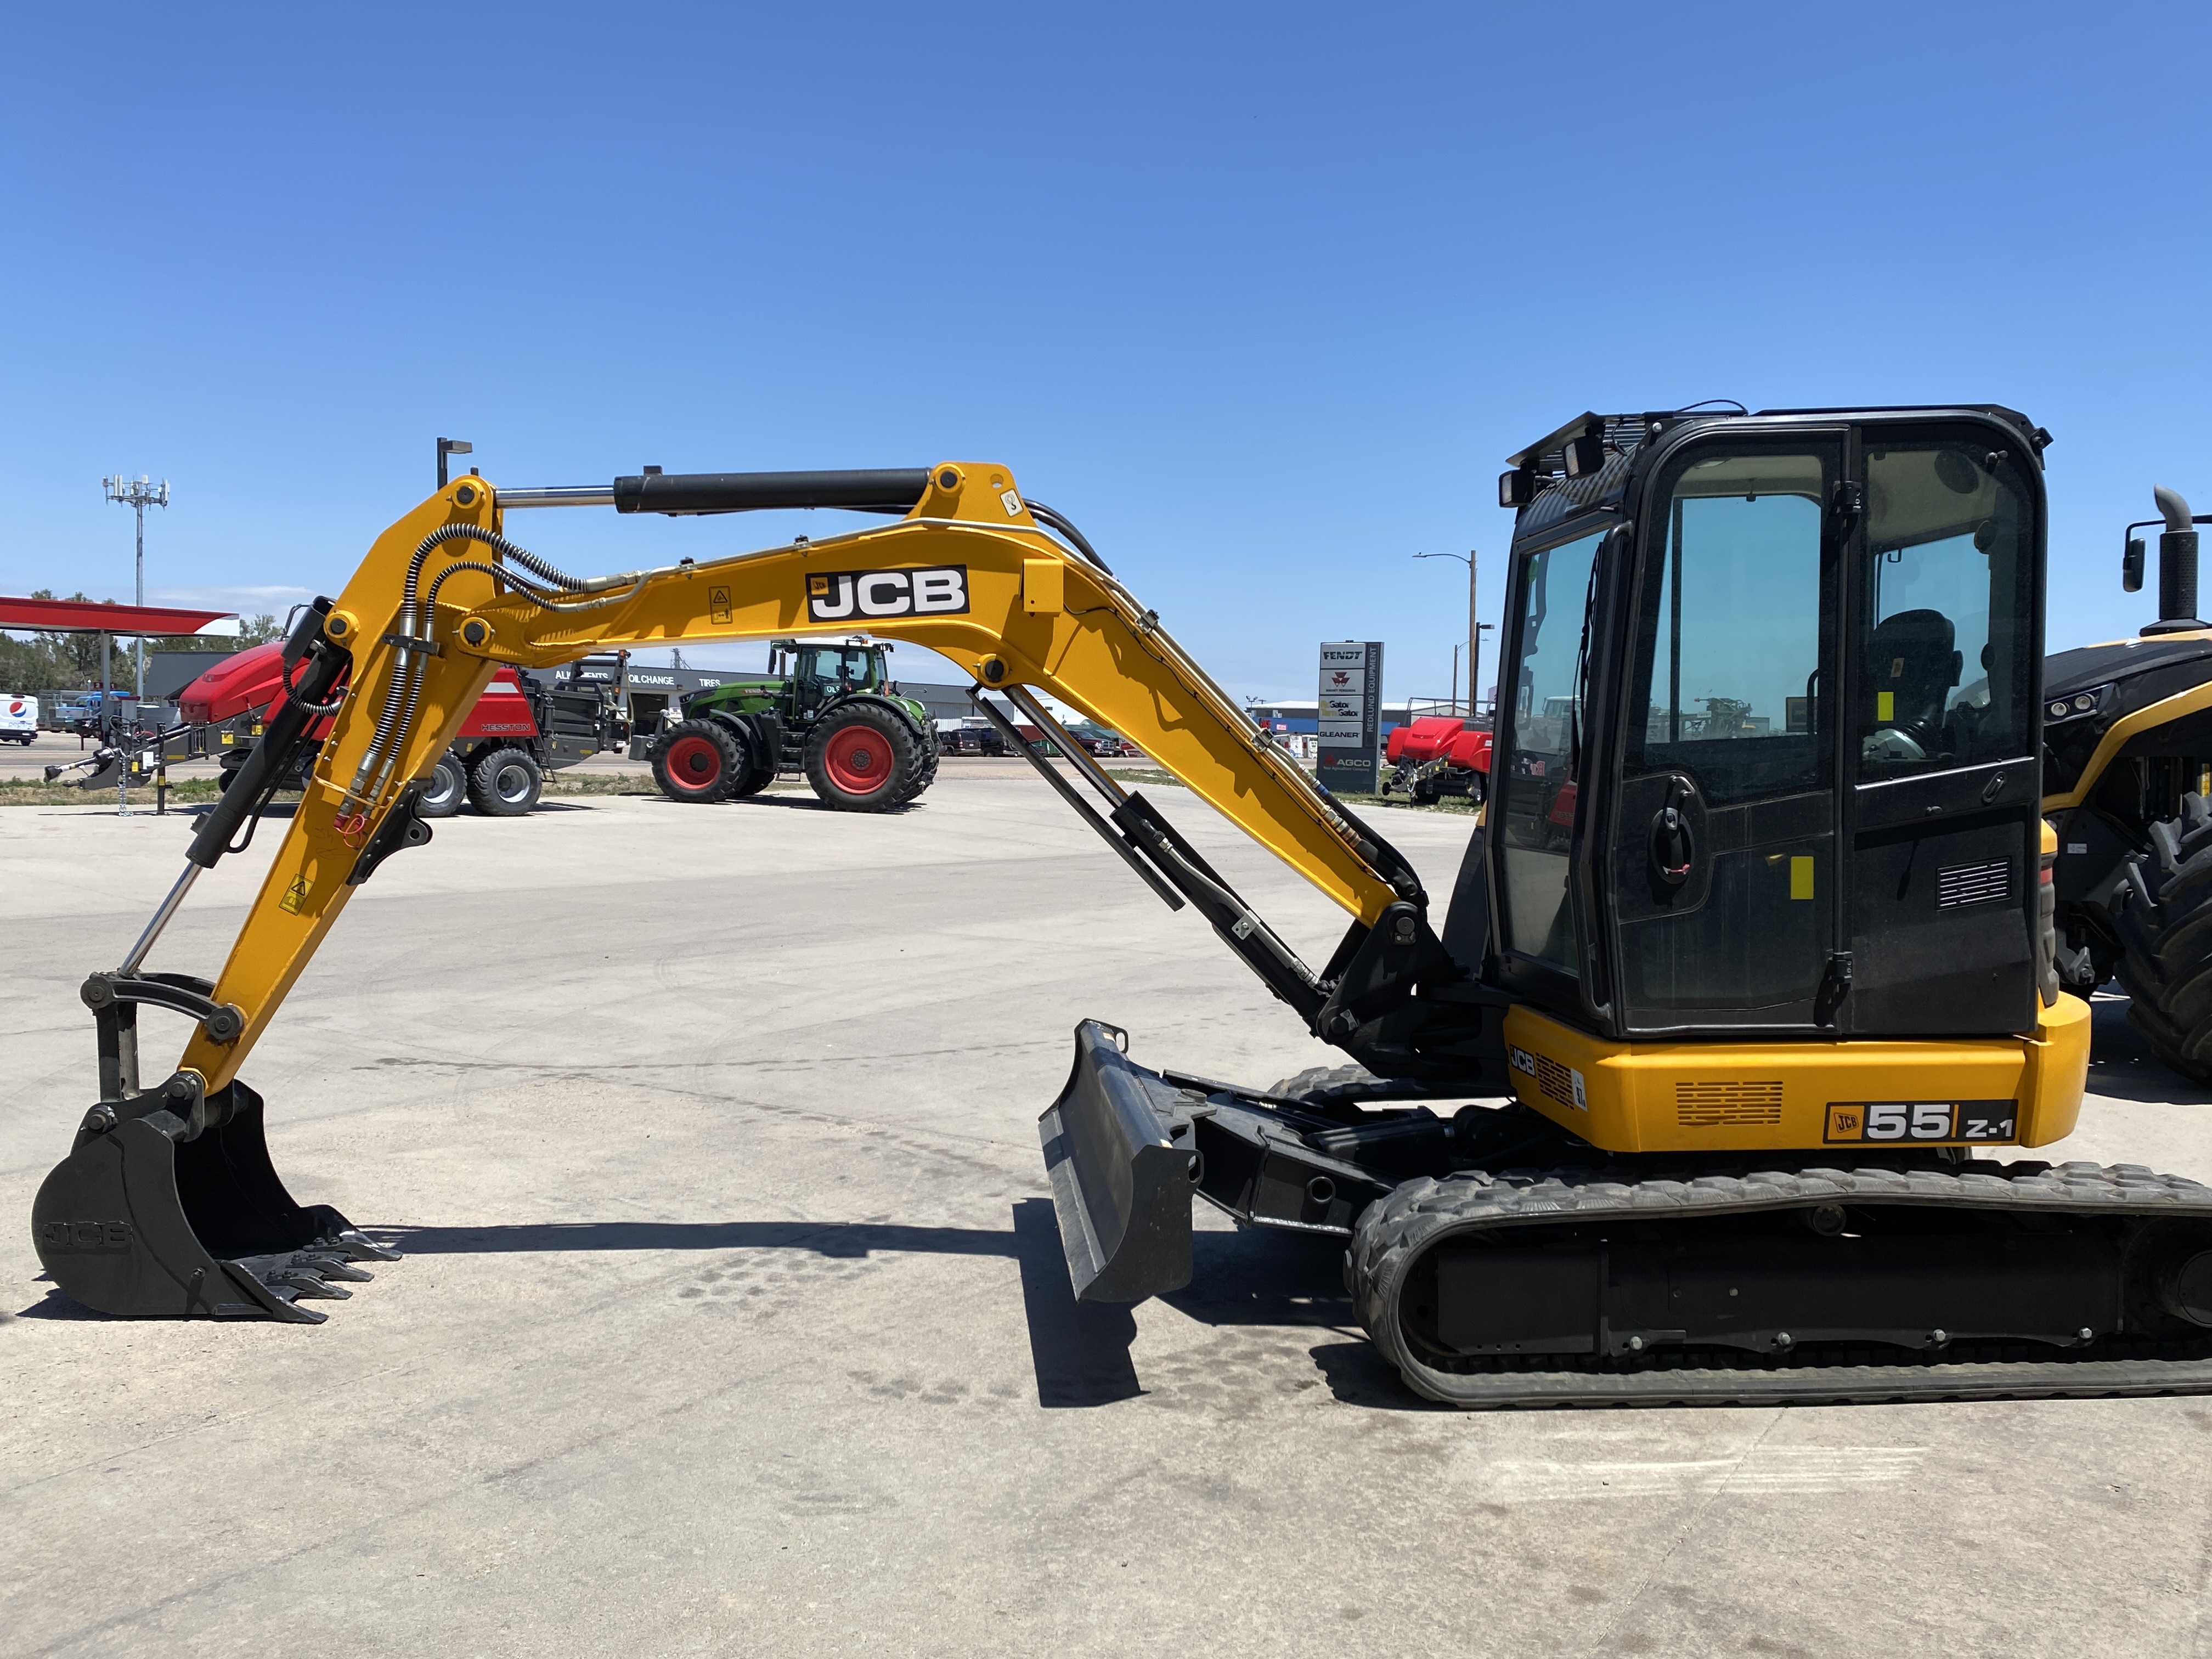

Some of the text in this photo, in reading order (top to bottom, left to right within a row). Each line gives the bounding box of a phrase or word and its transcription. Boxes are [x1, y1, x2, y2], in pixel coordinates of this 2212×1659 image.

[812, 570, 965, 618] JCB
[1323, 651, 1362, 659] FENDT
[628, 674, 674, 685] OIL CHANGE
[699, 678, 720, 687] TIRES
[1368, 647, 1377, 693] EQUIPMENT
[1511, 1048, 1535, 1076] JCB
[1838, 1114, 1857, 1131] JCB
[1867, 1104, 2013, 1139] 55 Z-1
[42, 1221, 134, 1248] JCB
